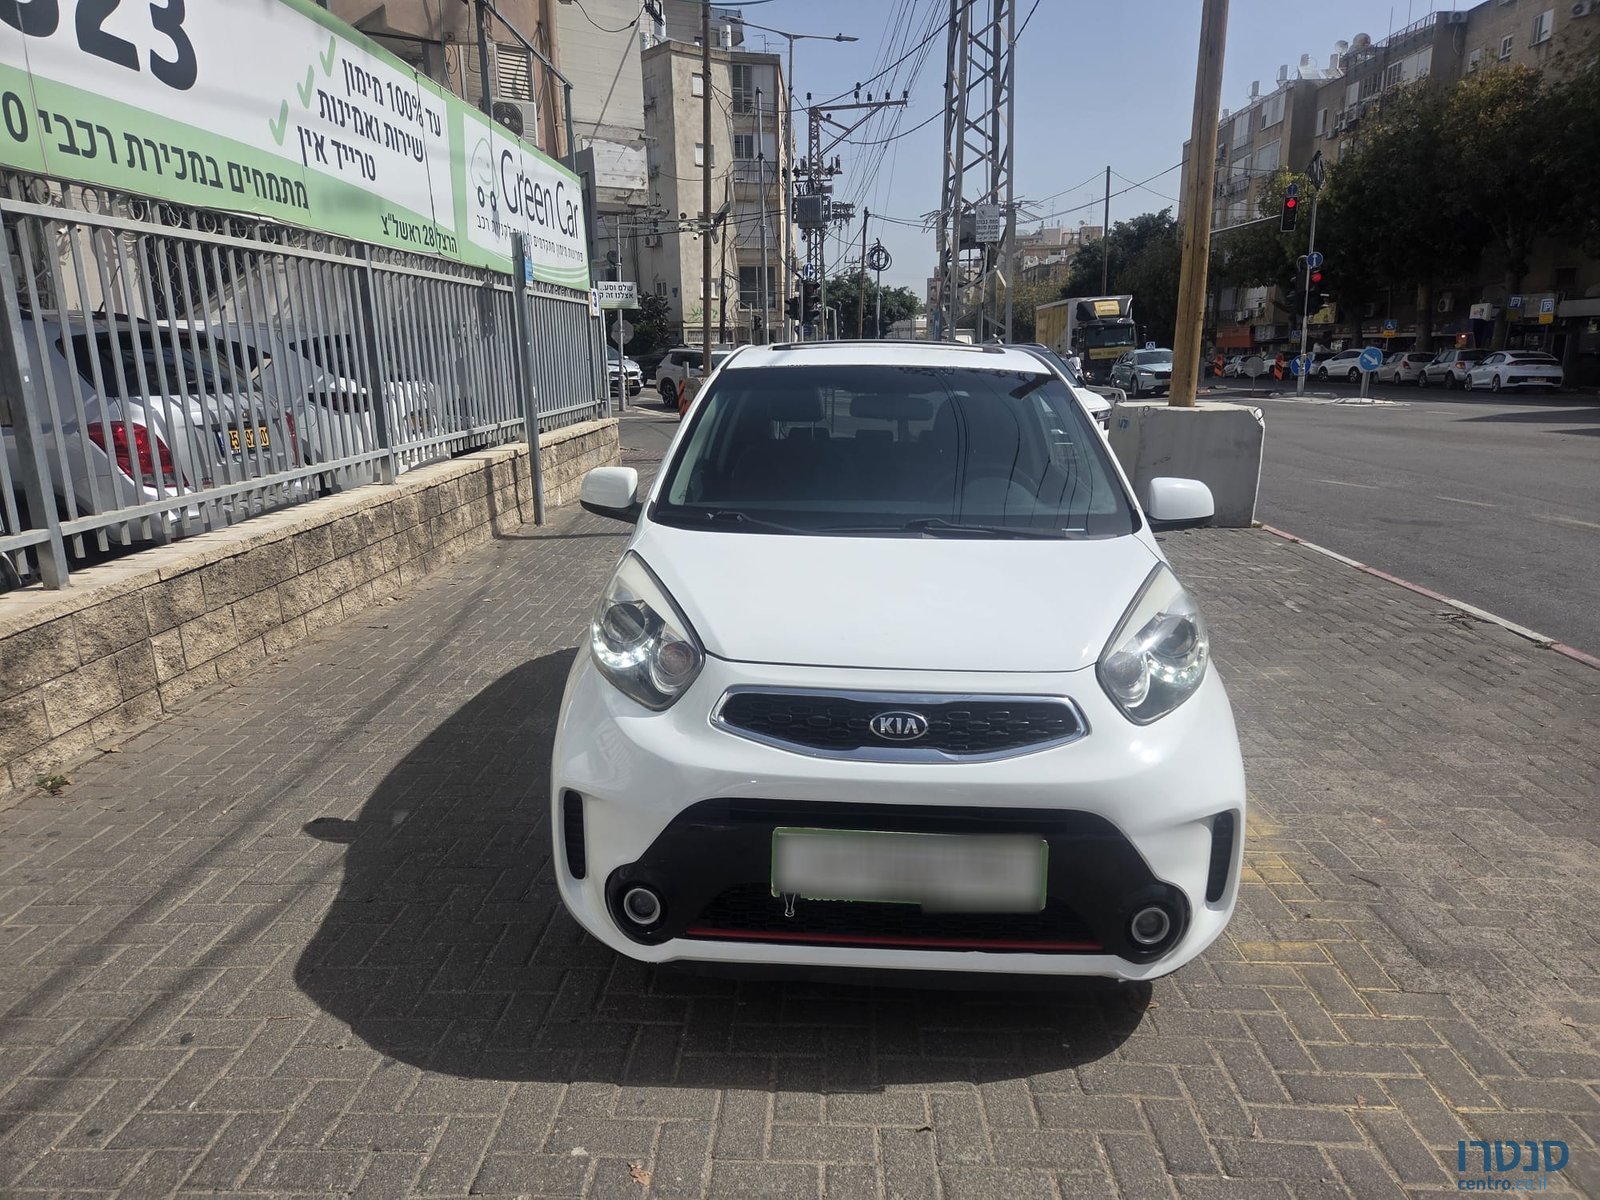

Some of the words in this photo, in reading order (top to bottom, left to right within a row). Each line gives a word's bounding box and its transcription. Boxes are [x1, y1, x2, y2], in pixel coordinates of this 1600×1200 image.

[342, 58, 384, 106] מימון
[317, 88, 381, 144] ואמינות
[386, 82, 424, 127] 100%
[425, 108, 441, 137] עד
[37, 109, 118, 165] רכבי
[297, 125, 328, 168] אין
[383, 122, 423, 163] שירות
[123, 132, 224, 189] במכירת
[330, 139, 376, 181] טרייד
[227, 161, 310, 210] מתמחים
[500, 149, 555, 230] Green
[555, 180, 579, 239] Car
[422, 225, 435, 247] 28
[435, 227, 458, 253] הרצל
[615, 291, 634, 299] אצלנו
[879, 717, 919, 735] KIA
